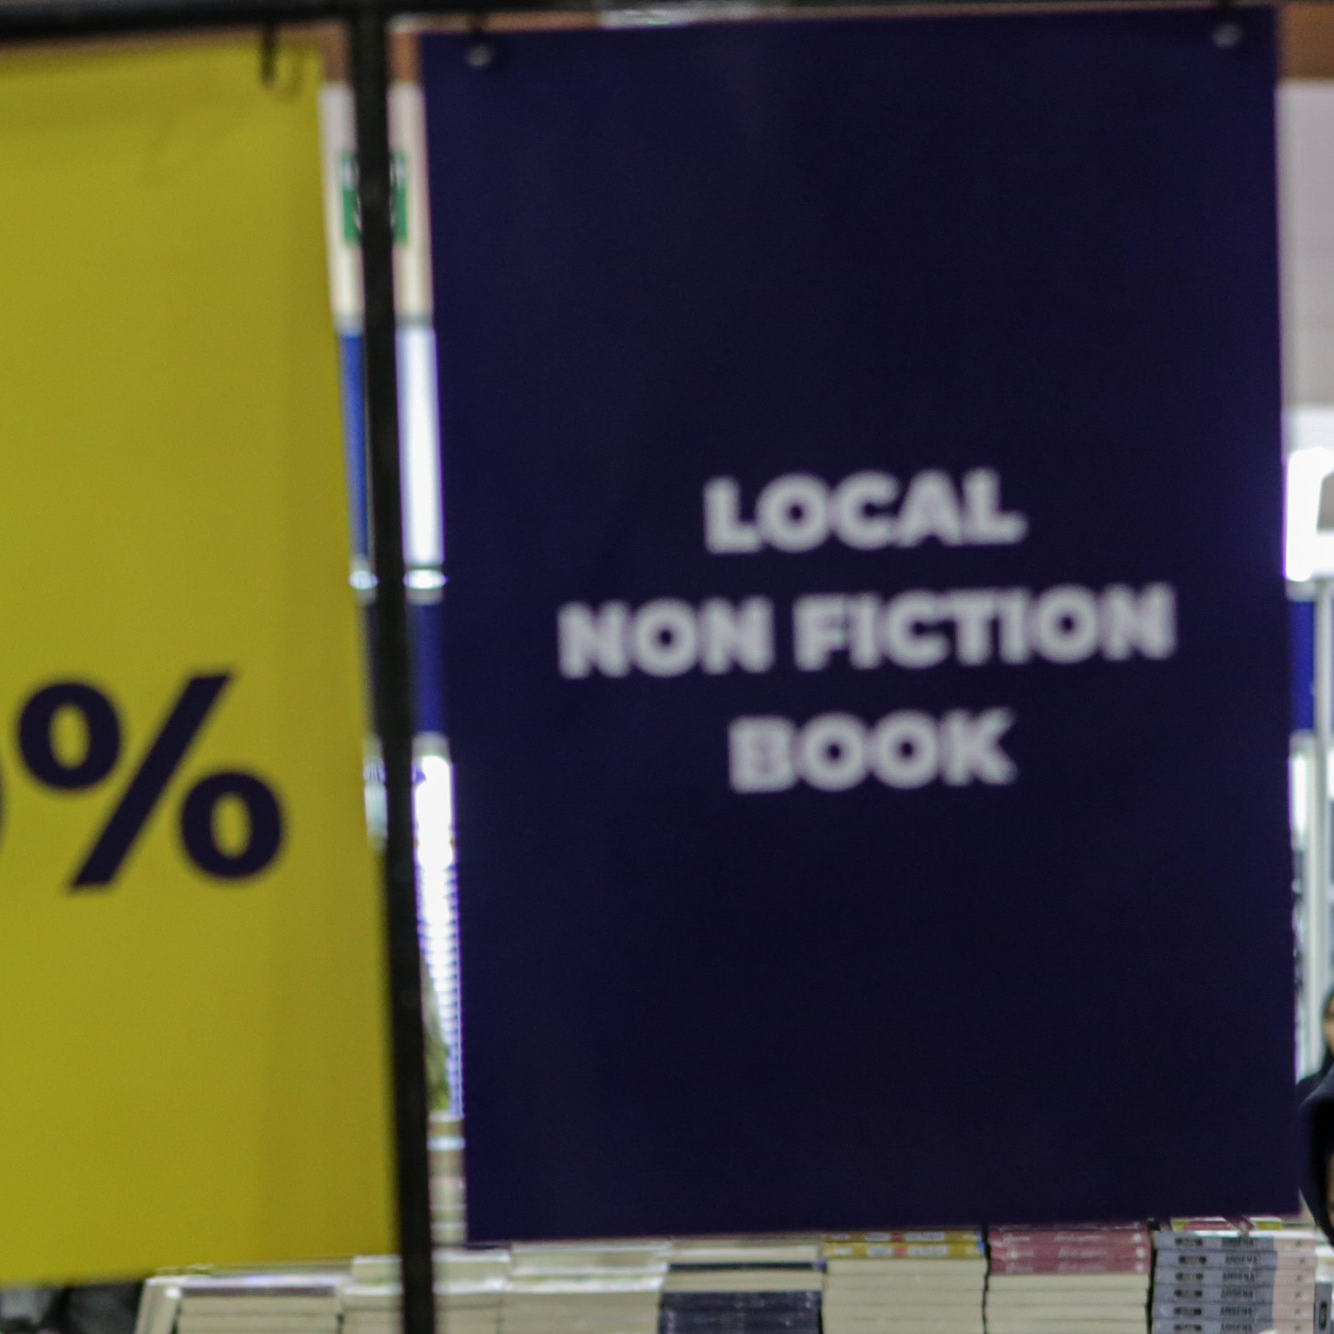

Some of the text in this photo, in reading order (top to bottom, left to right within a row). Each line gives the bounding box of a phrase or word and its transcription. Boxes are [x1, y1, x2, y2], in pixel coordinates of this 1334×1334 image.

[702, 466, 1029, 554] LOCAL
[556, 582, 1178, 679] NON FICTION
[727, 707, 1017, 793] BOOK
